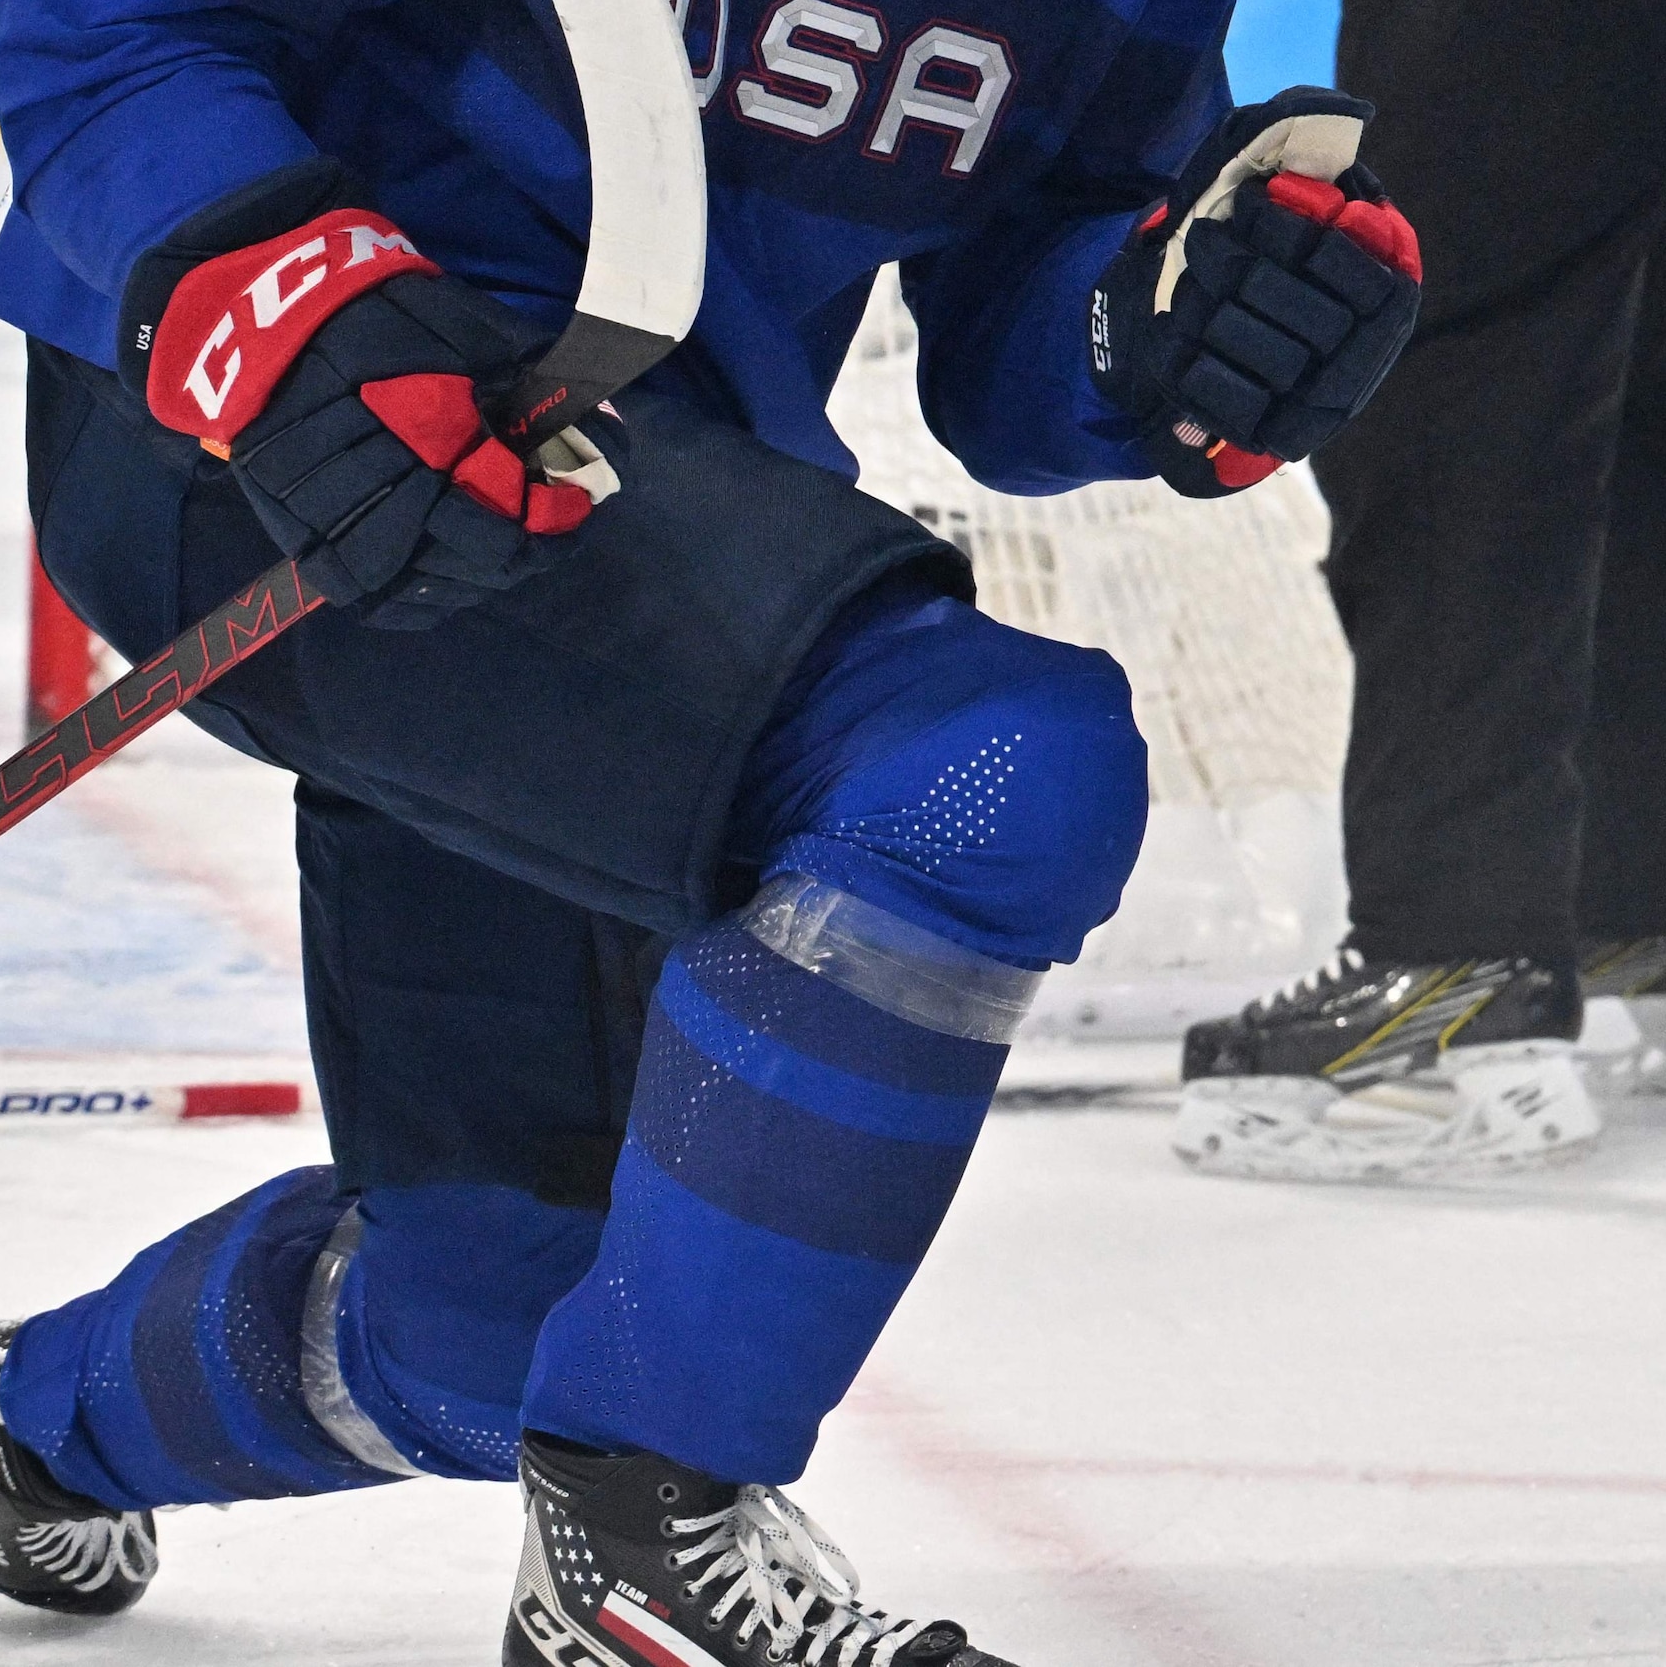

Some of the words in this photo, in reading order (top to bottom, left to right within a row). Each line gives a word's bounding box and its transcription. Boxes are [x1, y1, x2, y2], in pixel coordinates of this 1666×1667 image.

[136, 323, 153, 352] USA
[182, 224, 421, 420] CCM
[1092, 288, 1106, 373] CCM
[613, 1578, 649, 1606] TEAM
